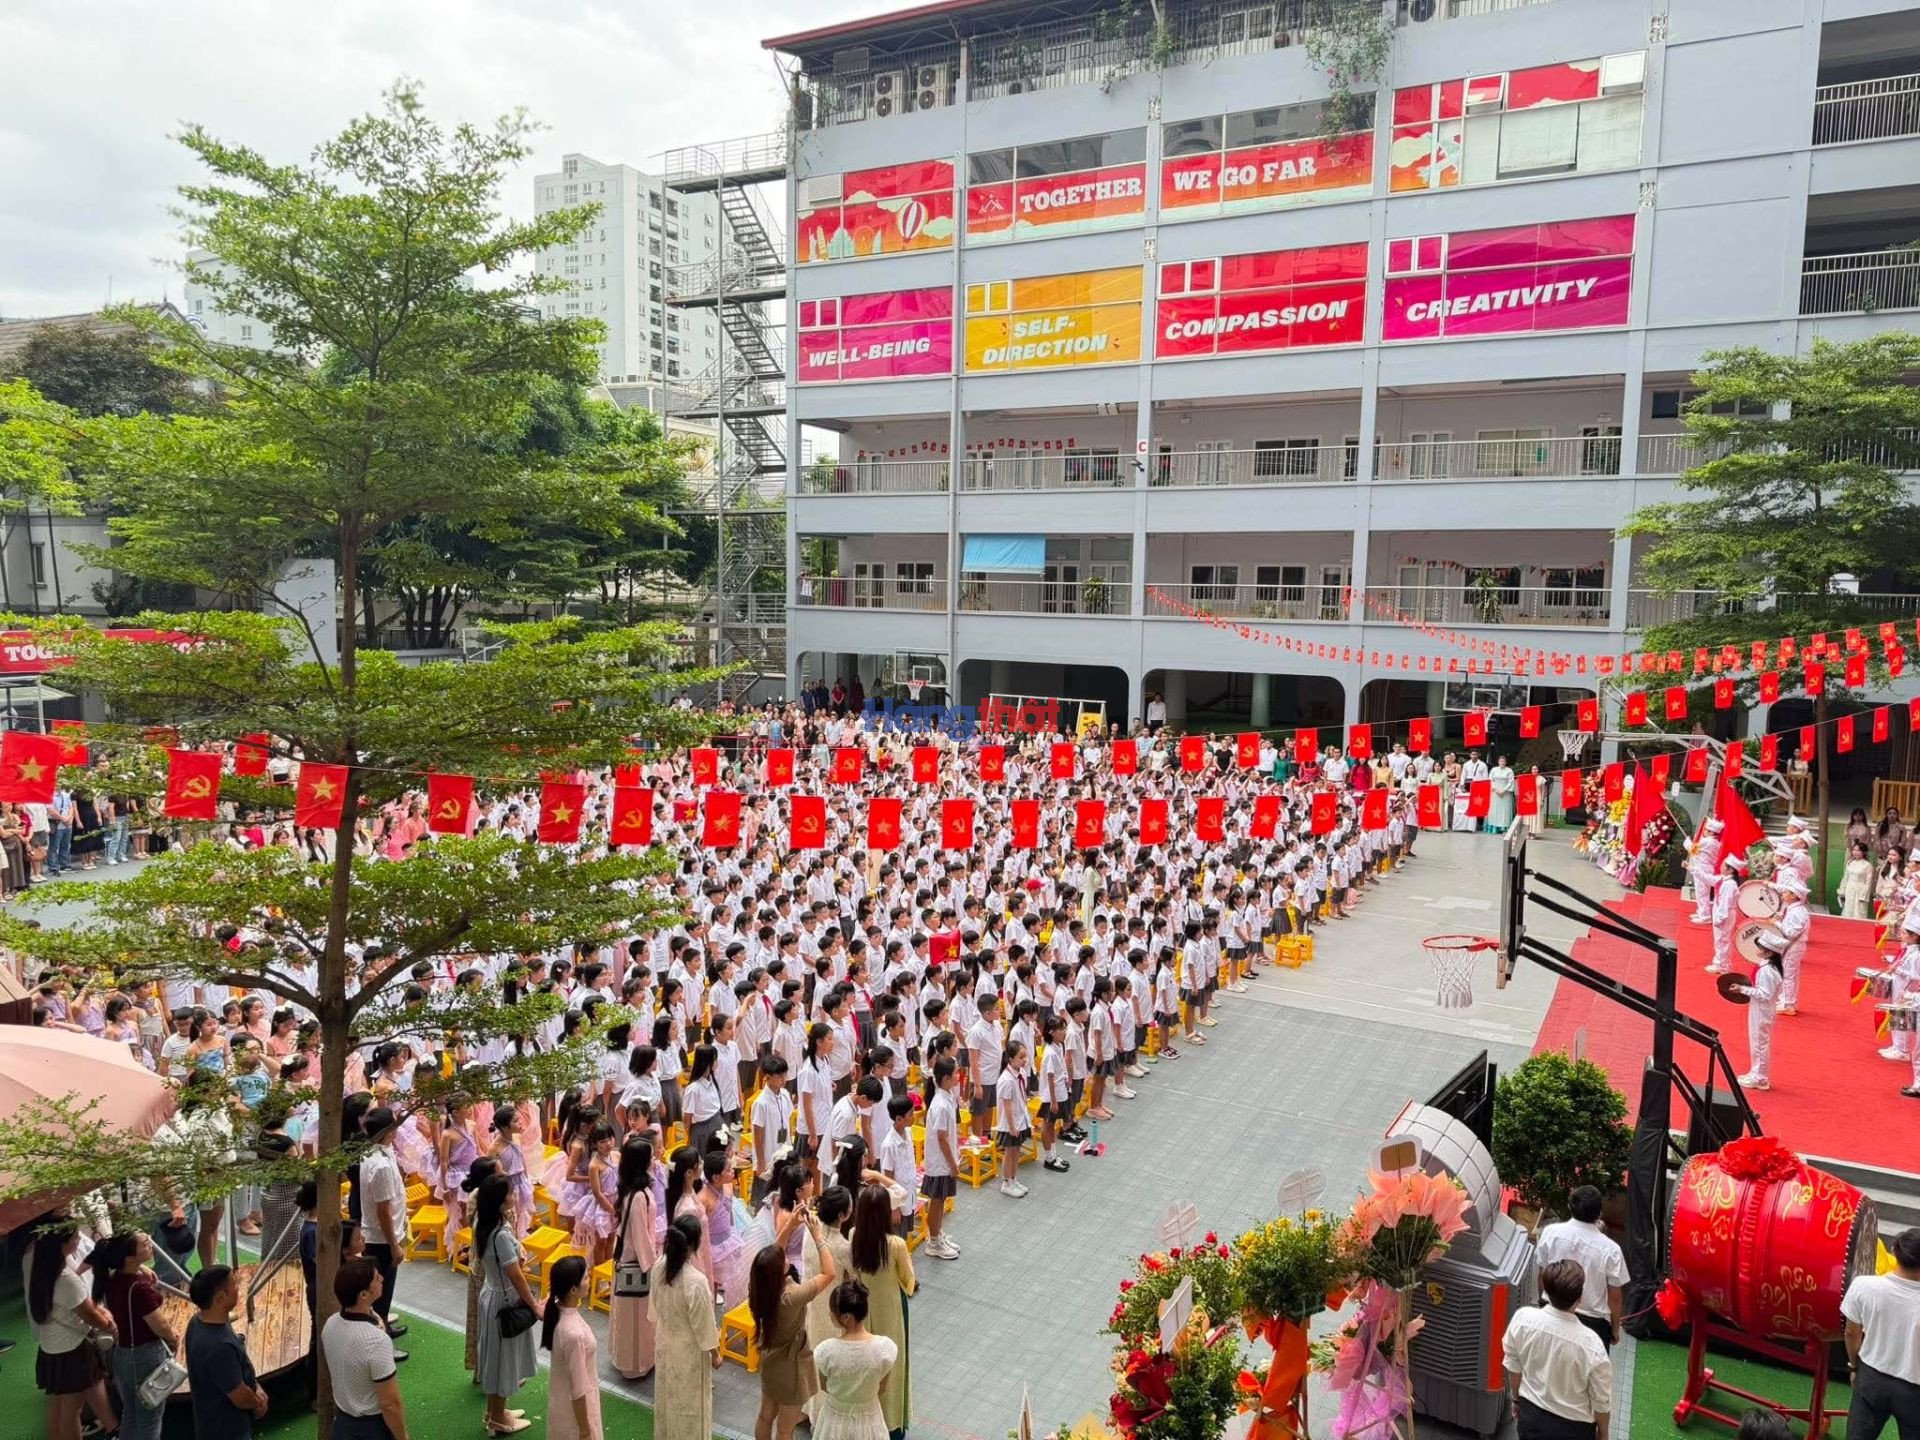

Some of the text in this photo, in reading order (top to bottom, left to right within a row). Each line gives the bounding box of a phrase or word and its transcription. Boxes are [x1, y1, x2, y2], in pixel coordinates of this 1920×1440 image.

[1173, 156, 1317, 191] WE GO FAR
[1020, 177, 1143, 213] TOGETHER
[1406, 277, 1598, 322] CREATIVITY
[1014, 315, 1076, 338] SELF-
[1165, 300, 1348, 340] COMPASSION
[809, 337, 931, 368] WELL-BEING
[982, 334, 1108, 365] DIRECTION
[1138, 441, 1147, 452] C
